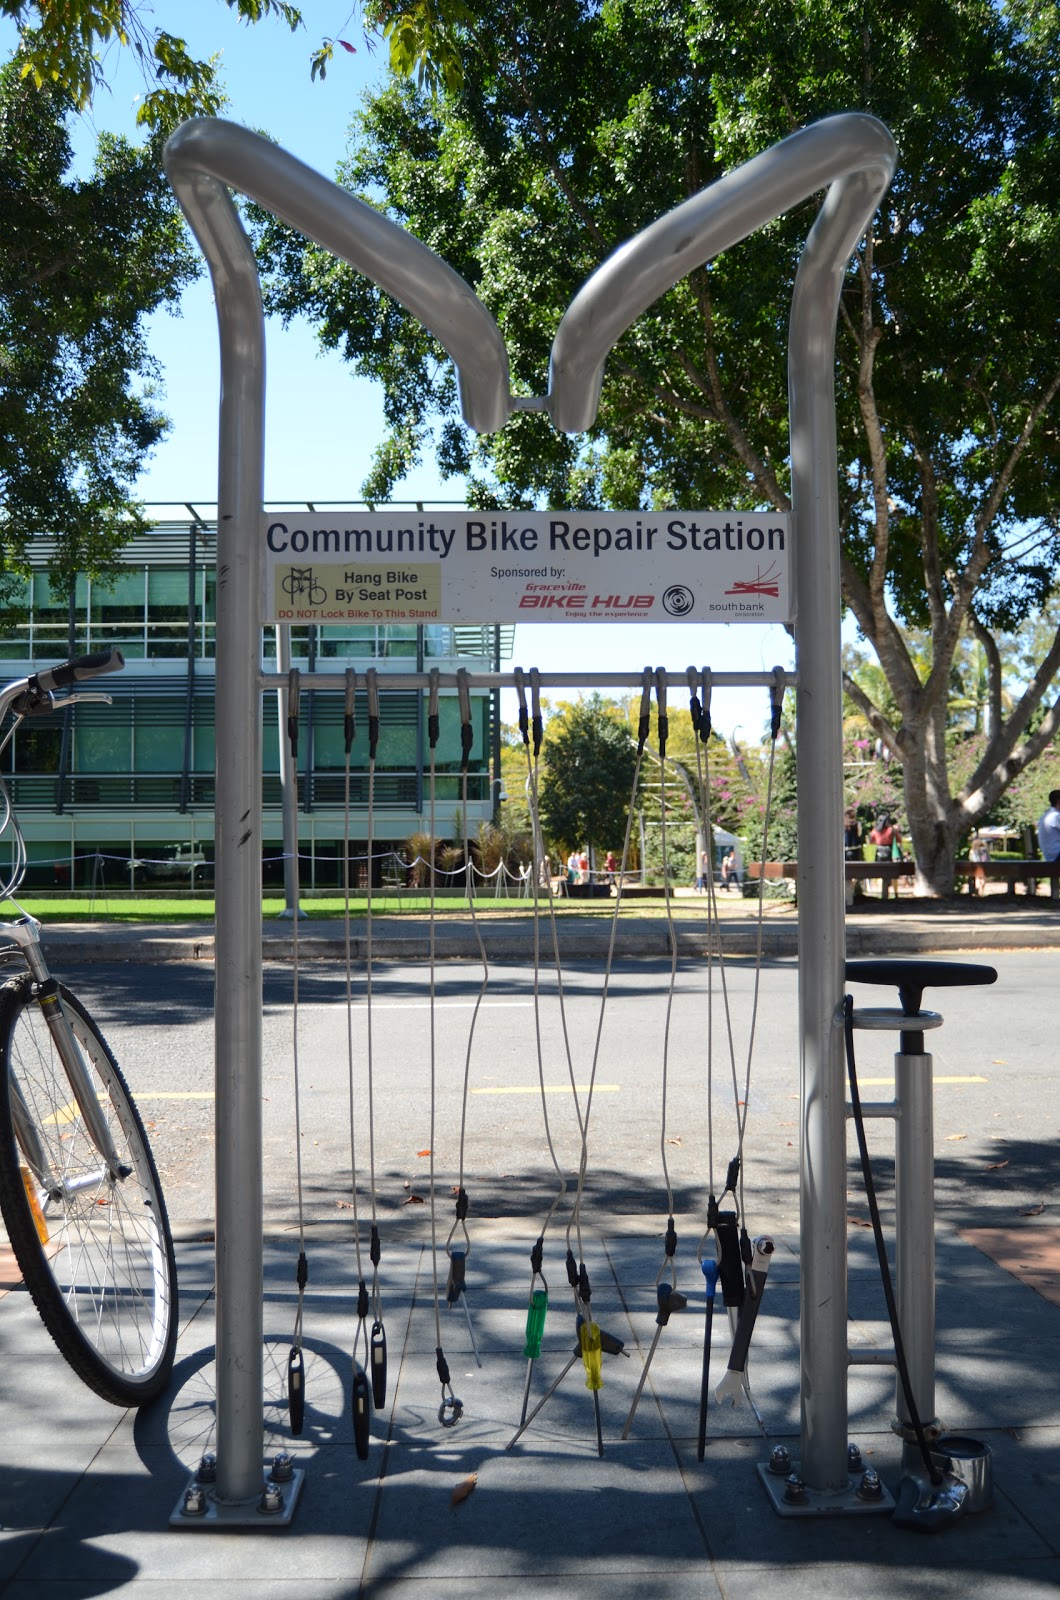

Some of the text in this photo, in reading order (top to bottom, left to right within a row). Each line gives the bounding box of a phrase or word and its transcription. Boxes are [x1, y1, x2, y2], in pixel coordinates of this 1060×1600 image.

[267, 520, 785, 558] Community Bike Repair Station
[344, 571, 418, 587] Hang Bike
[490, 566, 566, 579] Sponsored by:
[525, 583, 586, 592] Graceville
[335, 589, 428, 604] By Seat Post
[519, 595, 655, 608] BIKE HUB
[709, 602, 765, 611] south bank
[278, 609, 438, 619] DO NOT Lock Bike To This Stand
